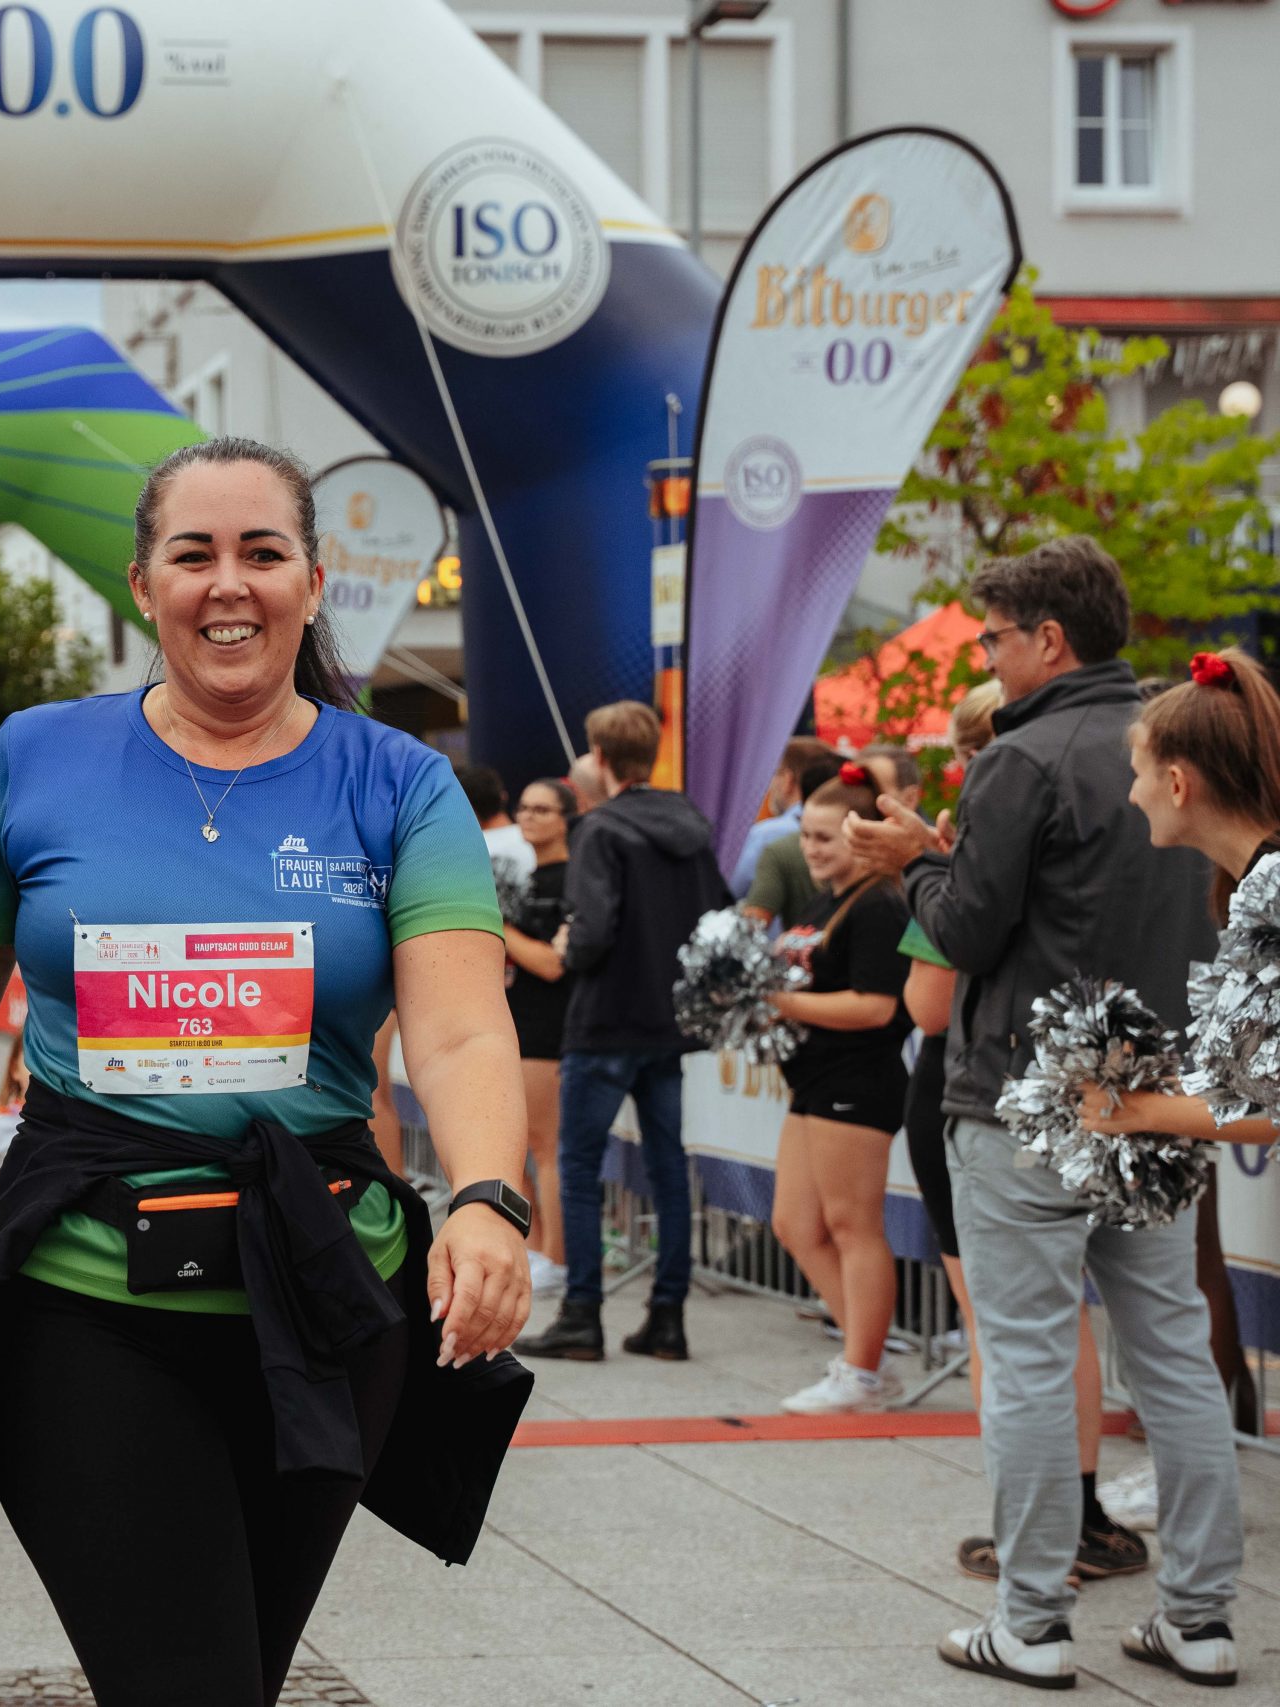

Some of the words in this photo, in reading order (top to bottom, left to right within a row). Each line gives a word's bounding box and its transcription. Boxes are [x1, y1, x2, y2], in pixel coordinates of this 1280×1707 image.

[452, 201, 559, 260] ISO
[747, 262, 976, 340] Bitburger
[282, 834, 306, 847] dm
[279, 859, 323, 873] FRAUEN
[280, 873, 324, 889] LAUF
[194, 942, 238, 952] HAUPTSACH
[261, 941, 288, 950] GELAAF
[127, 972, 261, 1009] Nicole
[177, 1018, 213, 1035] 763
[108, 1057, 124, 1068] dm
[177, 1268, 204, 1278] CRIVIT
